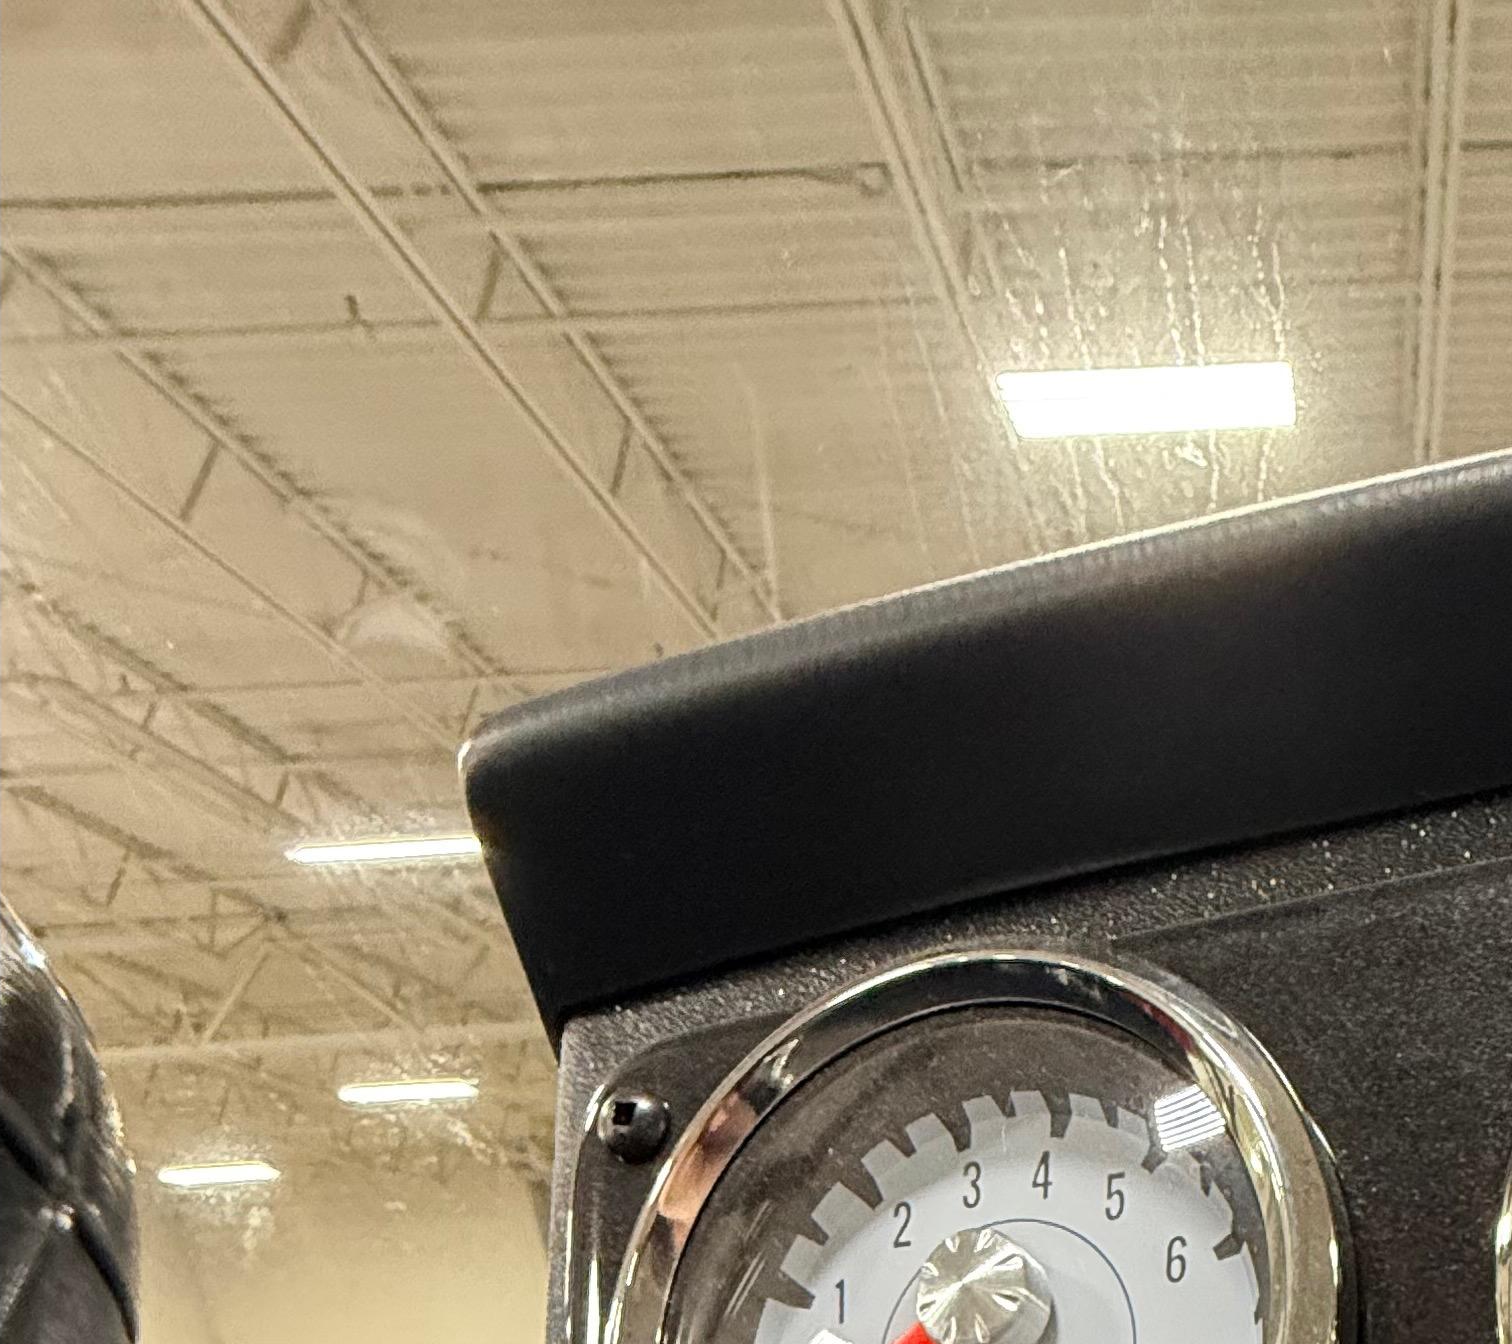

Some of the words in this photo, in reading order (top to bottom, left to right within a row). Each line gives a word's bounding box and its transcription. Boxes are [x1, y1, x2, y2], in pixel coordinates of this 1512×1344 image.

[963, 1162, 982, 1209] 3
[1032, 1152, 1053, 1199] 4
[1106, 1172, 1126, 1220] 5
[893, 1204, 913, 1248] 2
[1166, 1236, 1187, 1283] 6
[835, 1279, 846, 1325] 1
